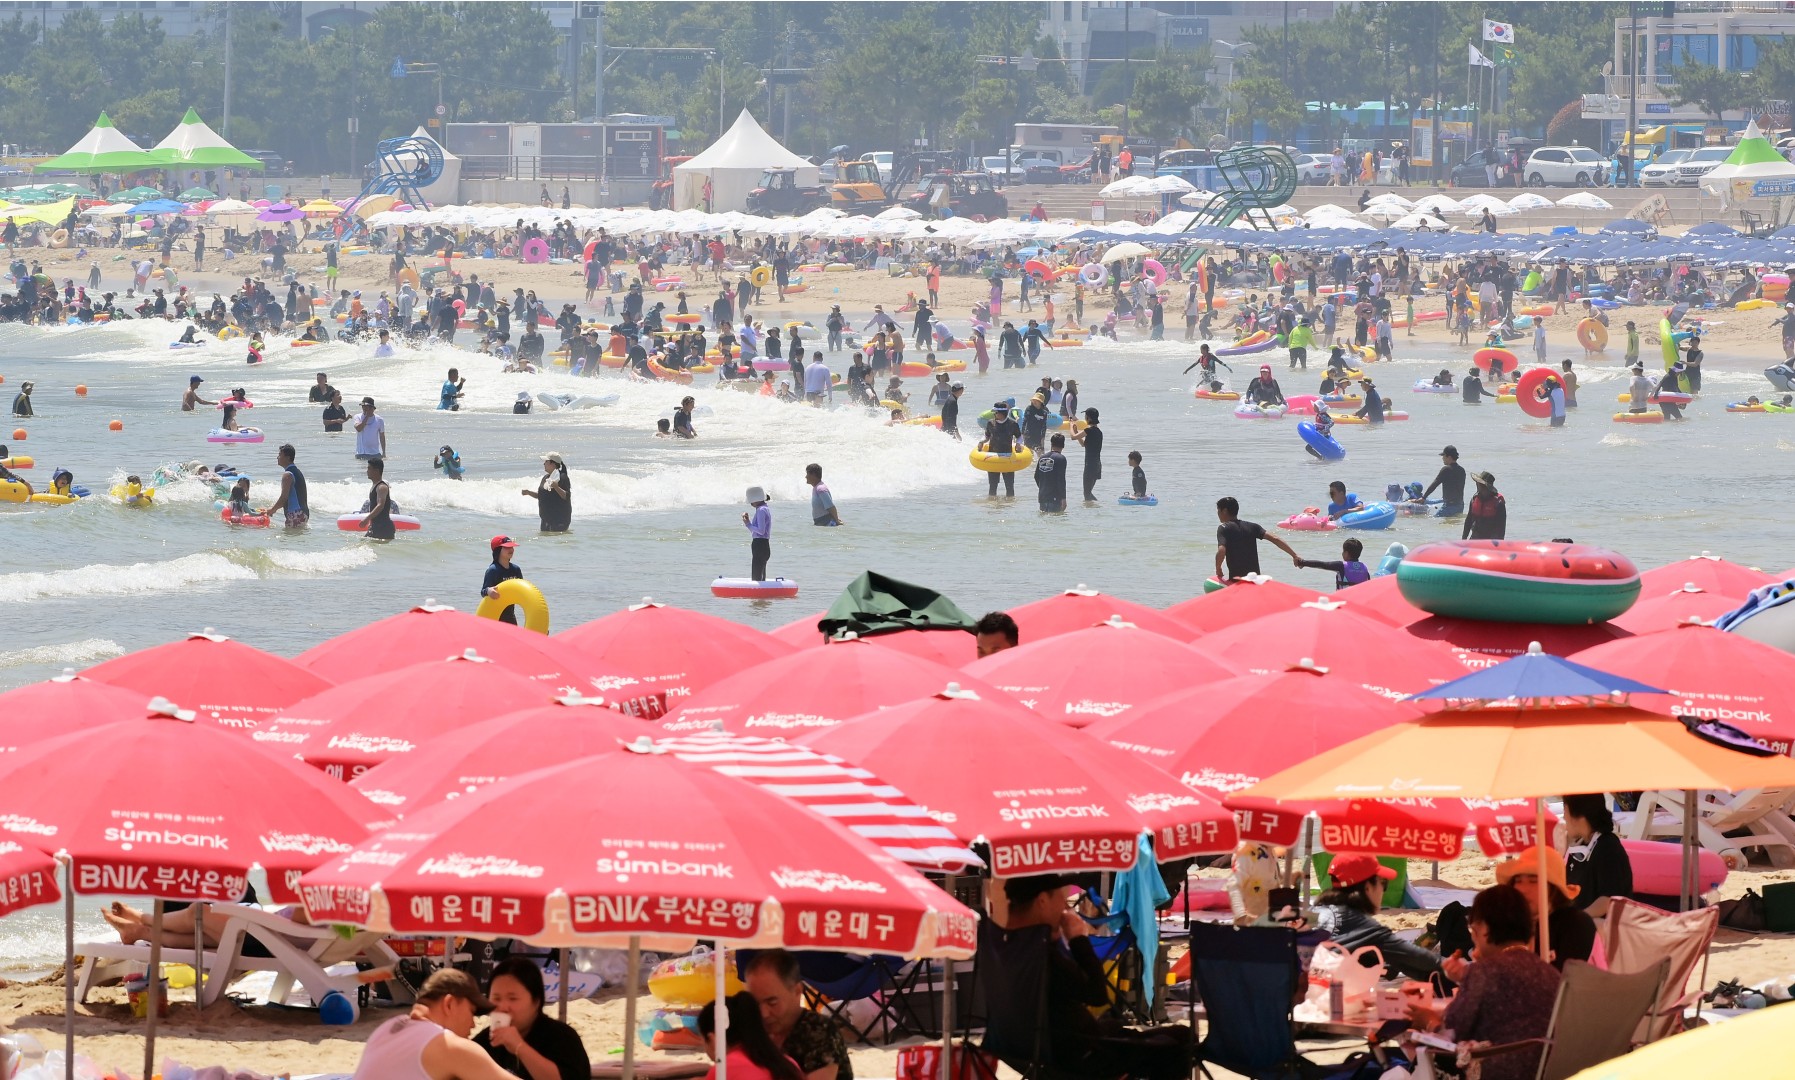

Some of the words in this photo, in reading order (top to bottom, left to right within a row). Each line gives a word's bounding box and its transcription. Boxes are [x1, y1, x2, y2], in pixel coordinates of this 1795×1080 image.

[1670, 700, 1773, 723] sumbank
[999, 800, 1110, 830] sumbank
[104, 821, 229, 851] sumbank
[1323, 824, 1379, 848] BNK
[1382, 825, 1457, 856] 부산은행
[596, 850, 734, 883] sumbank
[995, 841, 1055, 869] BNK
[1057, 838, 1134, 864] 부산은행
[80, 864, 149, 890] BNK
[153, 866, 245, 899] 부산은행
[410, 894, 521, 926] 해운대구
[574, 895, 650, 923] BNK
[654, 896, 755, 930] 부산은행
[798, 910, 896, 941] 해운대구
